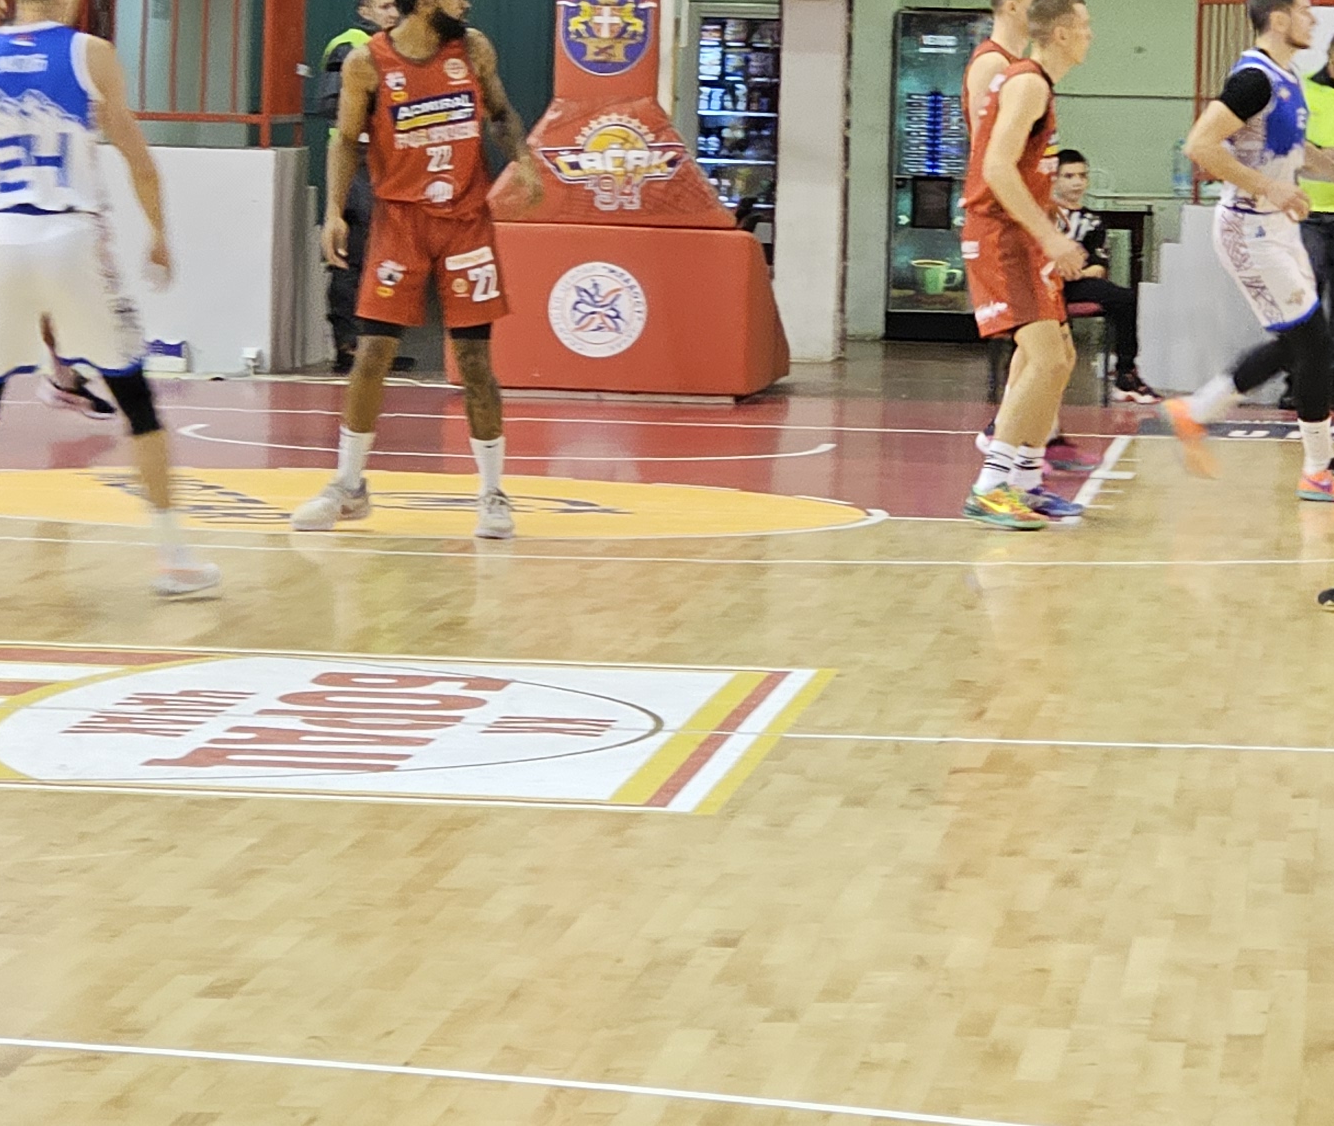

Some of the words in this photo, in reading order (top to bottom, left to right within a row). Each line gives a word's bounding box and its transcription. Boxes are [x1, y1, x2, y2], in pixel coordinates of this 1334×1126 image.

[60, 689, 258, 739] ЧАЧАК
[141, 671, 517, 773] БОРАЦ
[480, 716, 619, 739] КК
